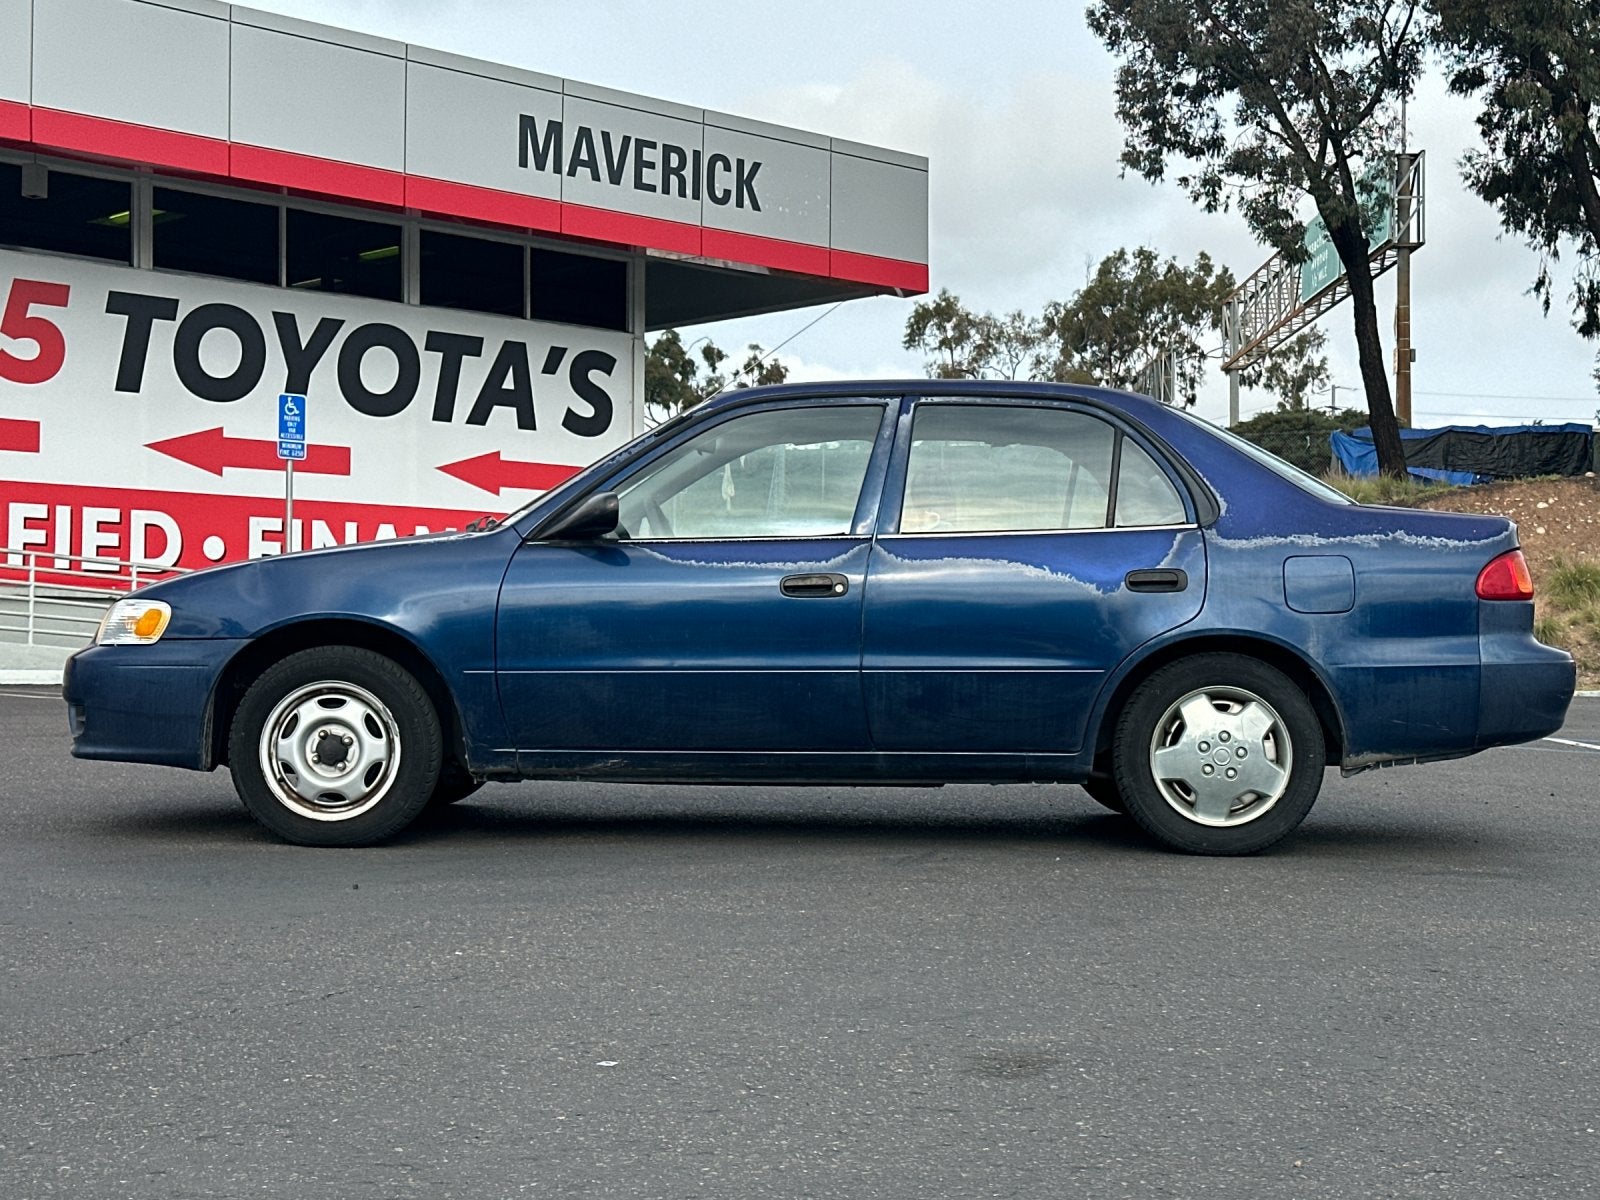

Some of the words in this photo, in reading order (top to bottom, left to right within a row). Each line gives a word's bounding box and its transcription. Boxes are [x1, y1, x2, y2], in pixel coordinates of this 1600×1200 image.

[518, 113, 763, 213] MAVERICK
[0, 277, 71, 385] 5
[105, 290, 618, 438] TOYOTA'S
[7, 502, 183, 574] FIED
